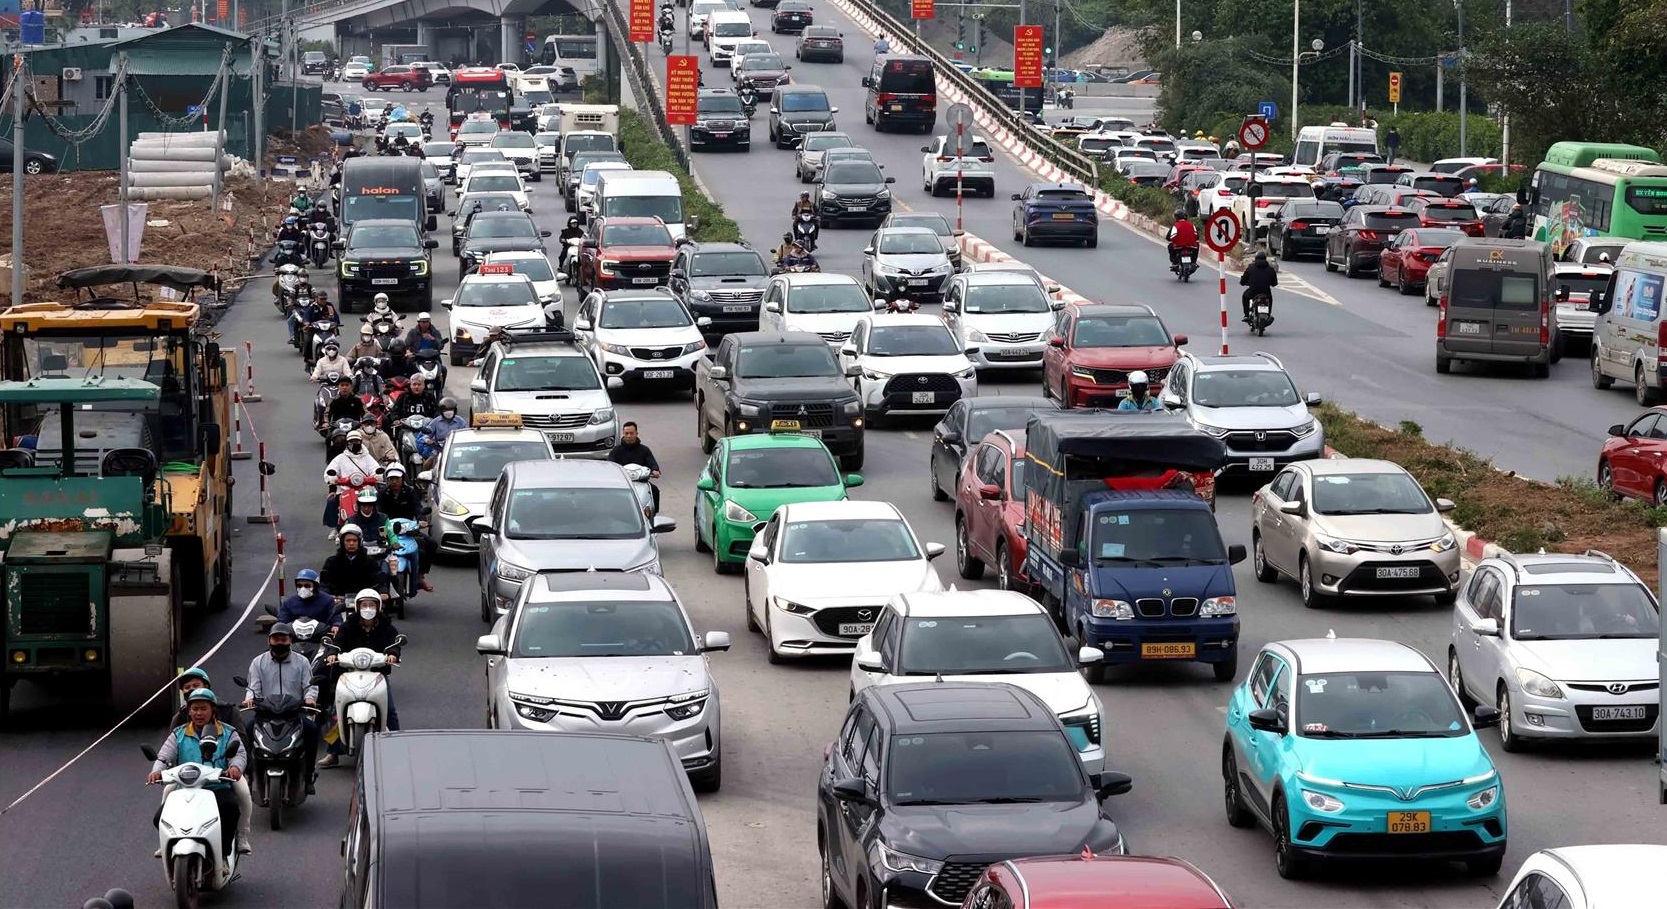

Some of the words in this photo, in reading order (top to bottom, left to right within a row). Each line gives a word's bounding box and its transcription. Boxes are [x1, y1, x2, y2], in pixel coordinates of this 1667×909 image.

[1146, 645, 1191, 654] 89H-086.93
[1594, 707, 1644, 719] 30A-743.10
[1399, 812, 1418, 822] 29K
[1392, 822, 1426, 832] 078.83
